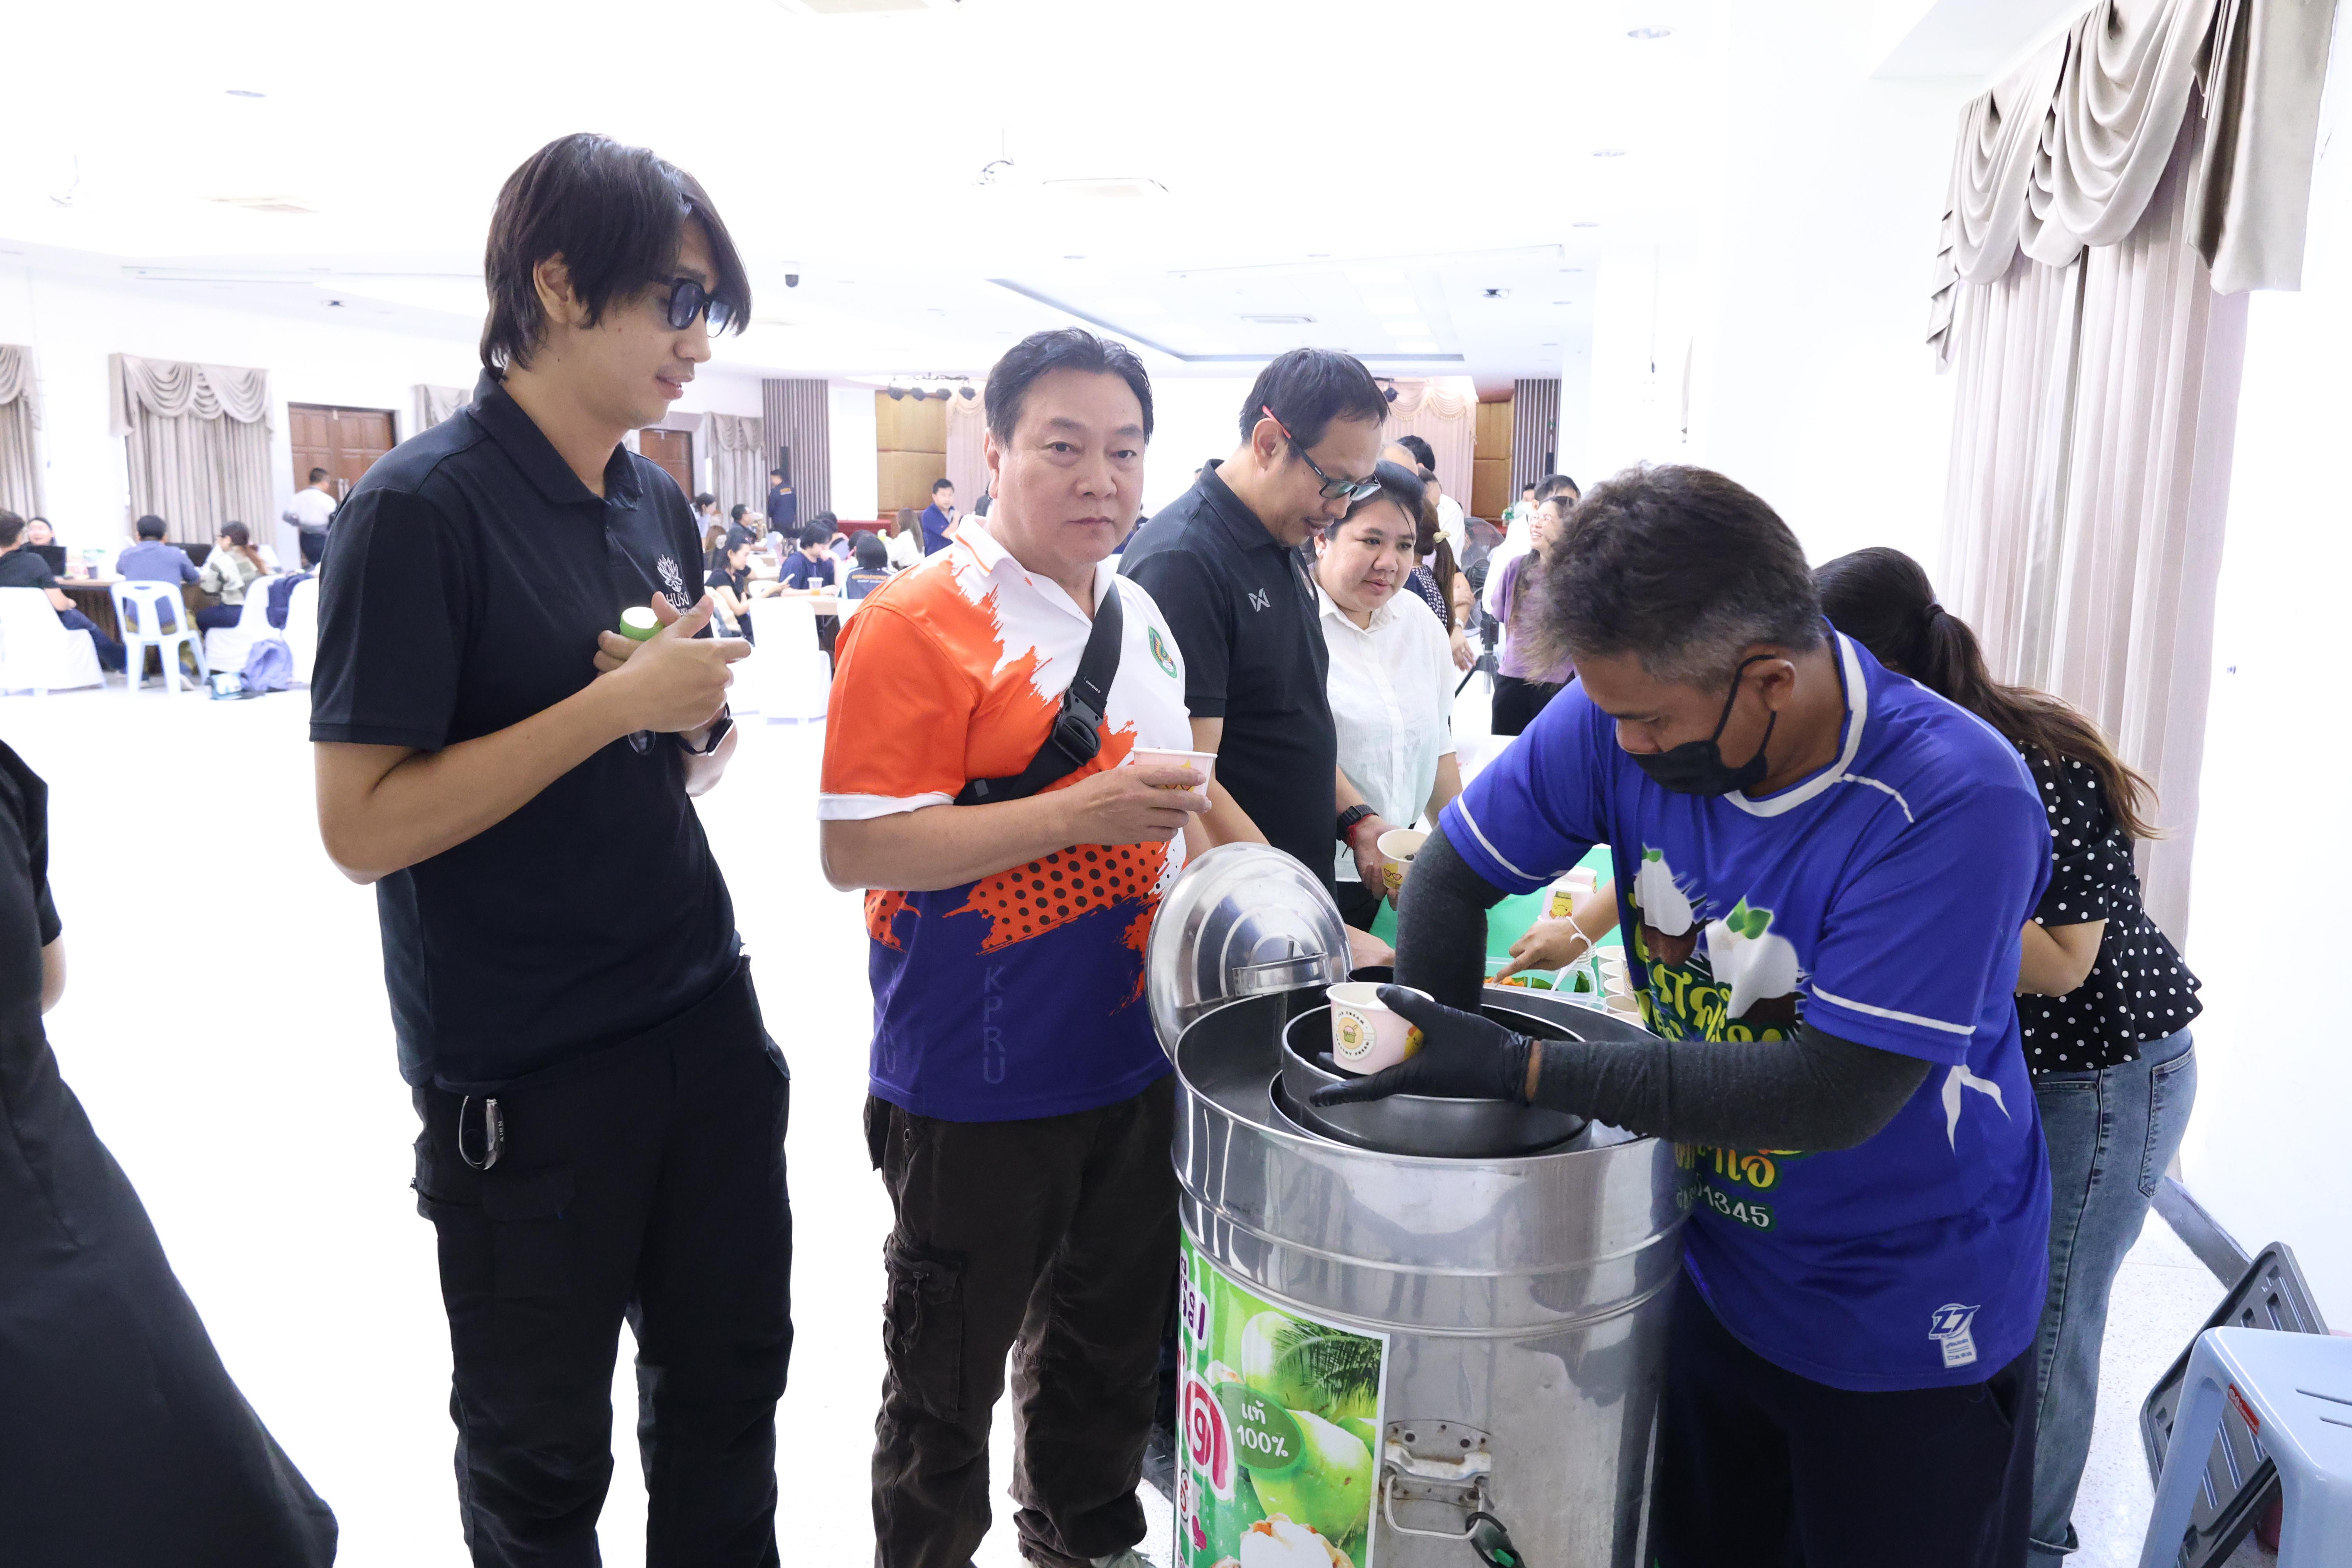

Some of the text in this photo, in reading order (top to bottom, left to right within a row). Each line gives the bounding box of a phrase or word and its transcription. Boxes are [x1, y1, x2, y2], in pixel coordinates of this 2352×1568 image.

[666, 591, 690, 607] HUSO
[983, 966, 1006, 1084] KPRU
[1346, 1011, 1364, 1024] CREAM
[1697, 1173, 1769, 1227] 1345
[1241, 1400, 1266, 1425] แท้
[1236, 1425, 1289, 1457] 100%
